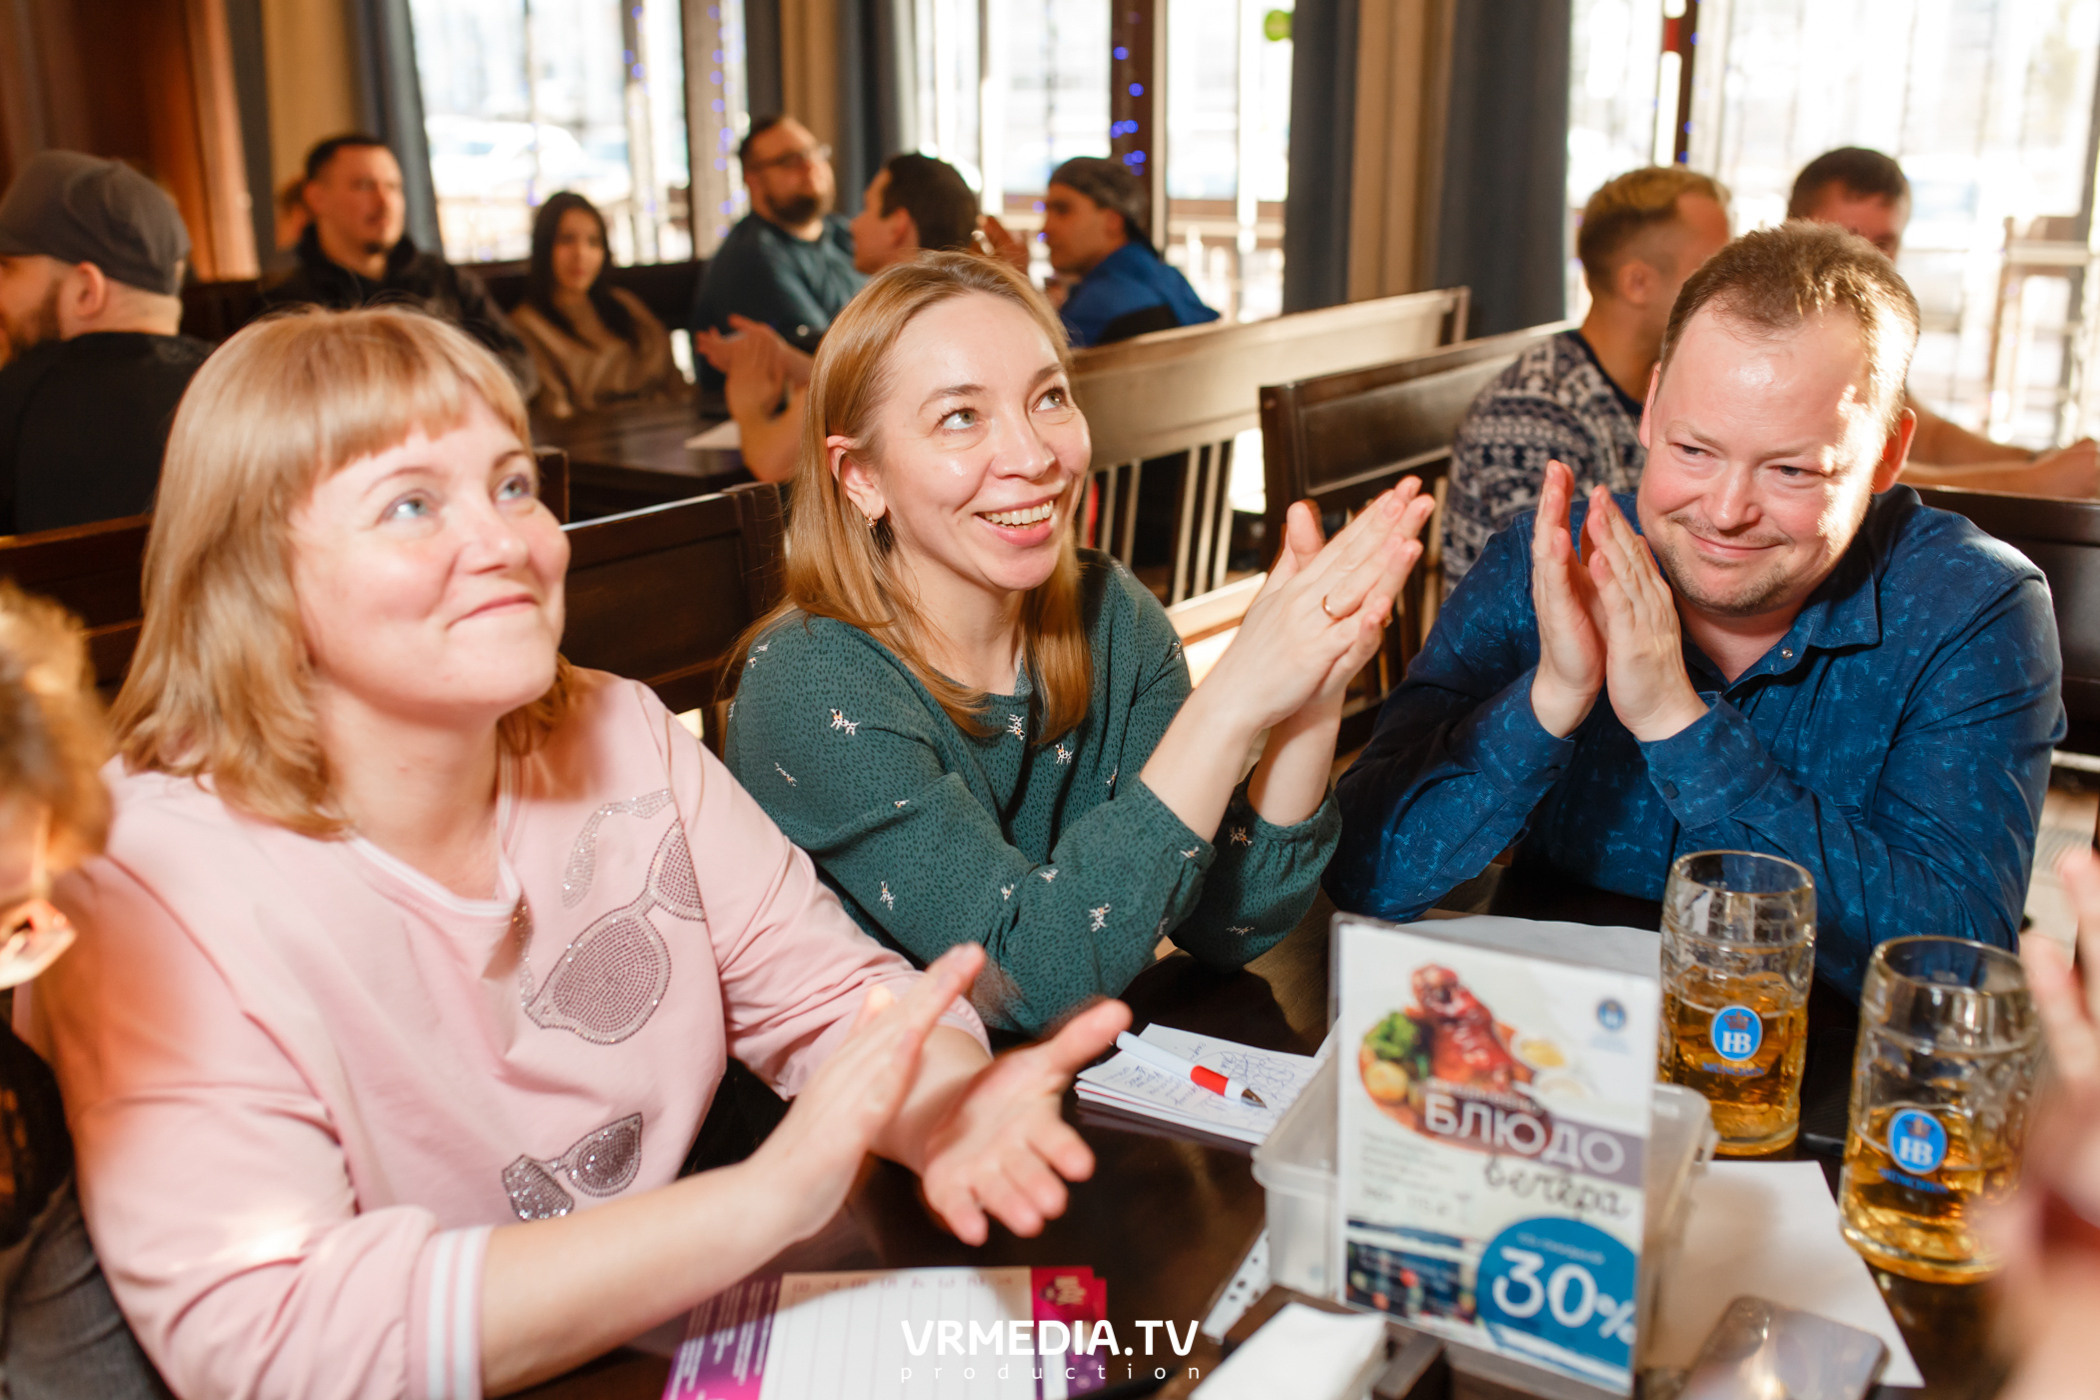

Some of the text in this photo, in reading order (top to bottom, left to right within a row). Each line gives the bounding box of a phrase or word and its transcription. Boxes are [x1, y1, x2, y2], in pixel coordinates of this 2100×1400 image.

[1722, 1031, 1752, 1054] HB
[1425, 1092, 1625, 1174] БЛЮДО
[1899, 1136, 1933, 1166] HB
[1492, 1246, 1636, 1346] 30%
